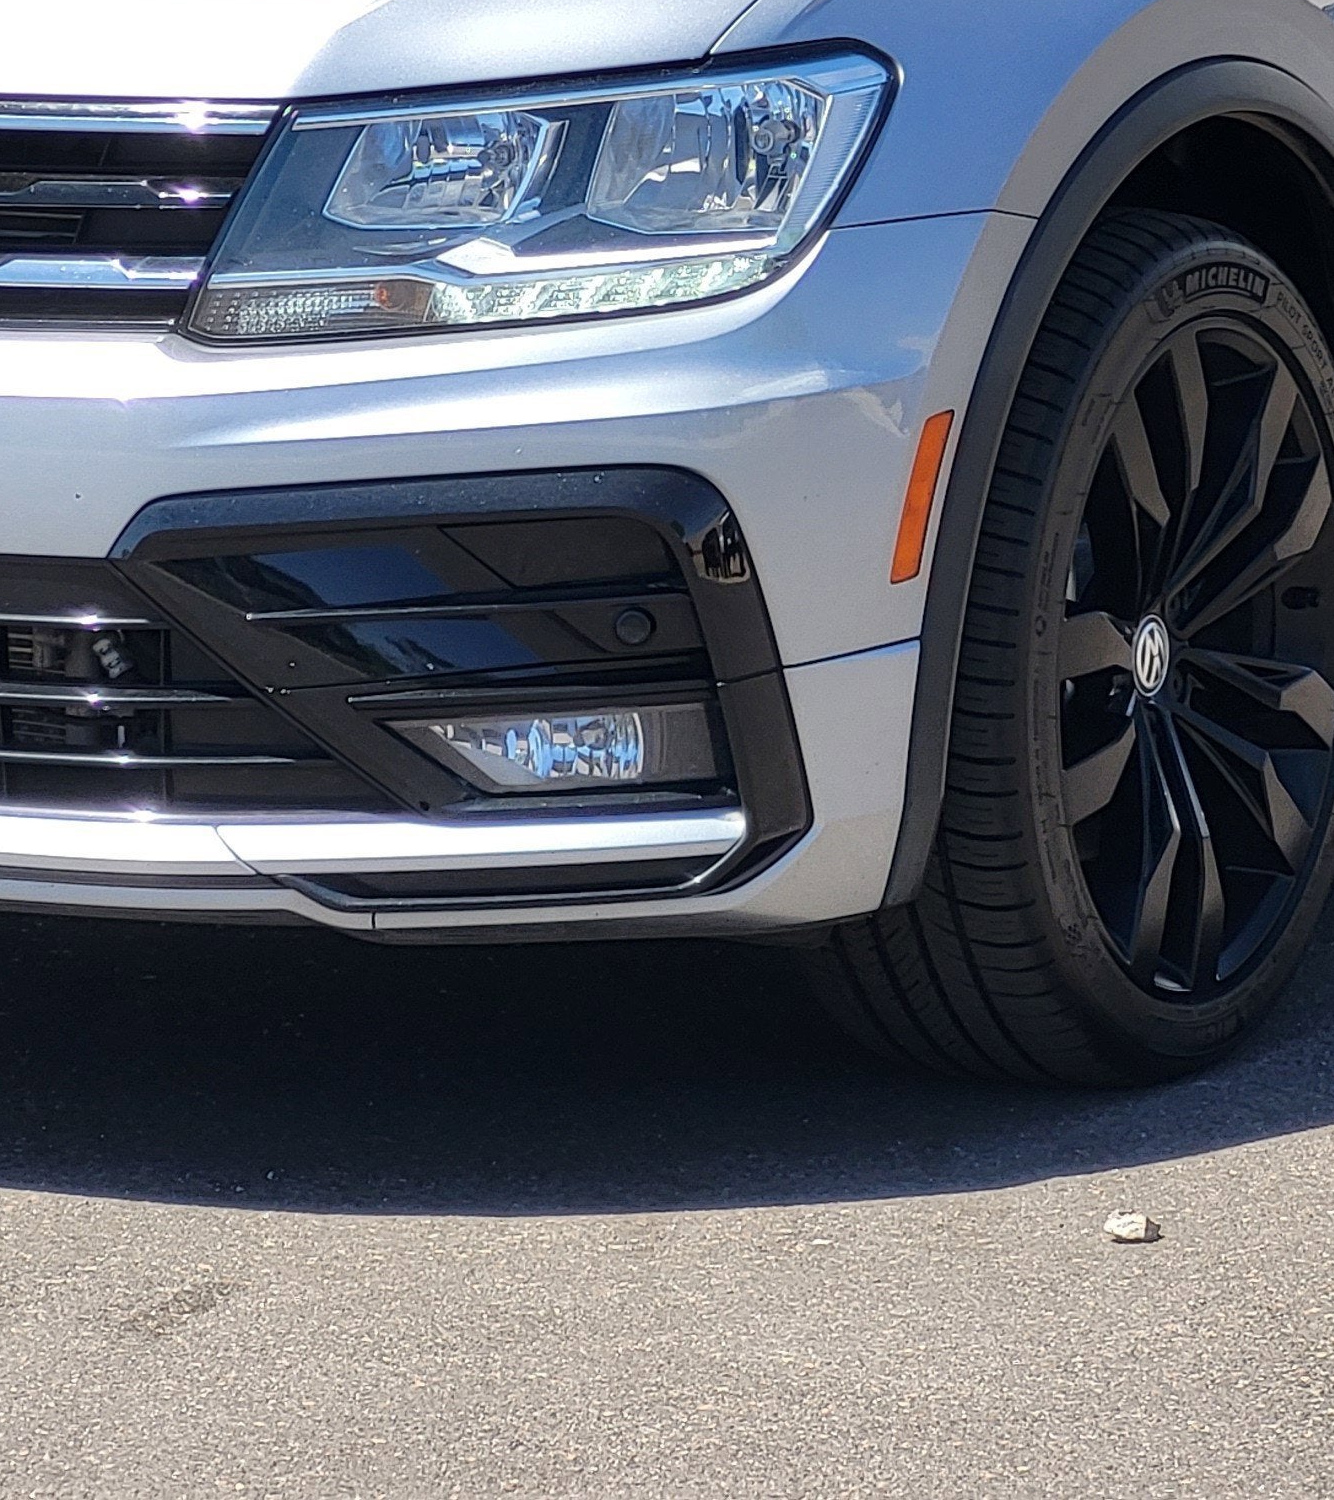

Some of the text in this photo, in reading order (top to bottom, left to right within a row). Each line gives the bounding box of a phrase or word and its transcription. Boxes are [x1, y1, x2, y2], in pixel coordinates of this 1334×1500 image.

[1185, 265, 1267, 297] MICHELIN
[1276, 290, 1302, 324] PILOT
[1302, 323, 1328, 369] SPORT
